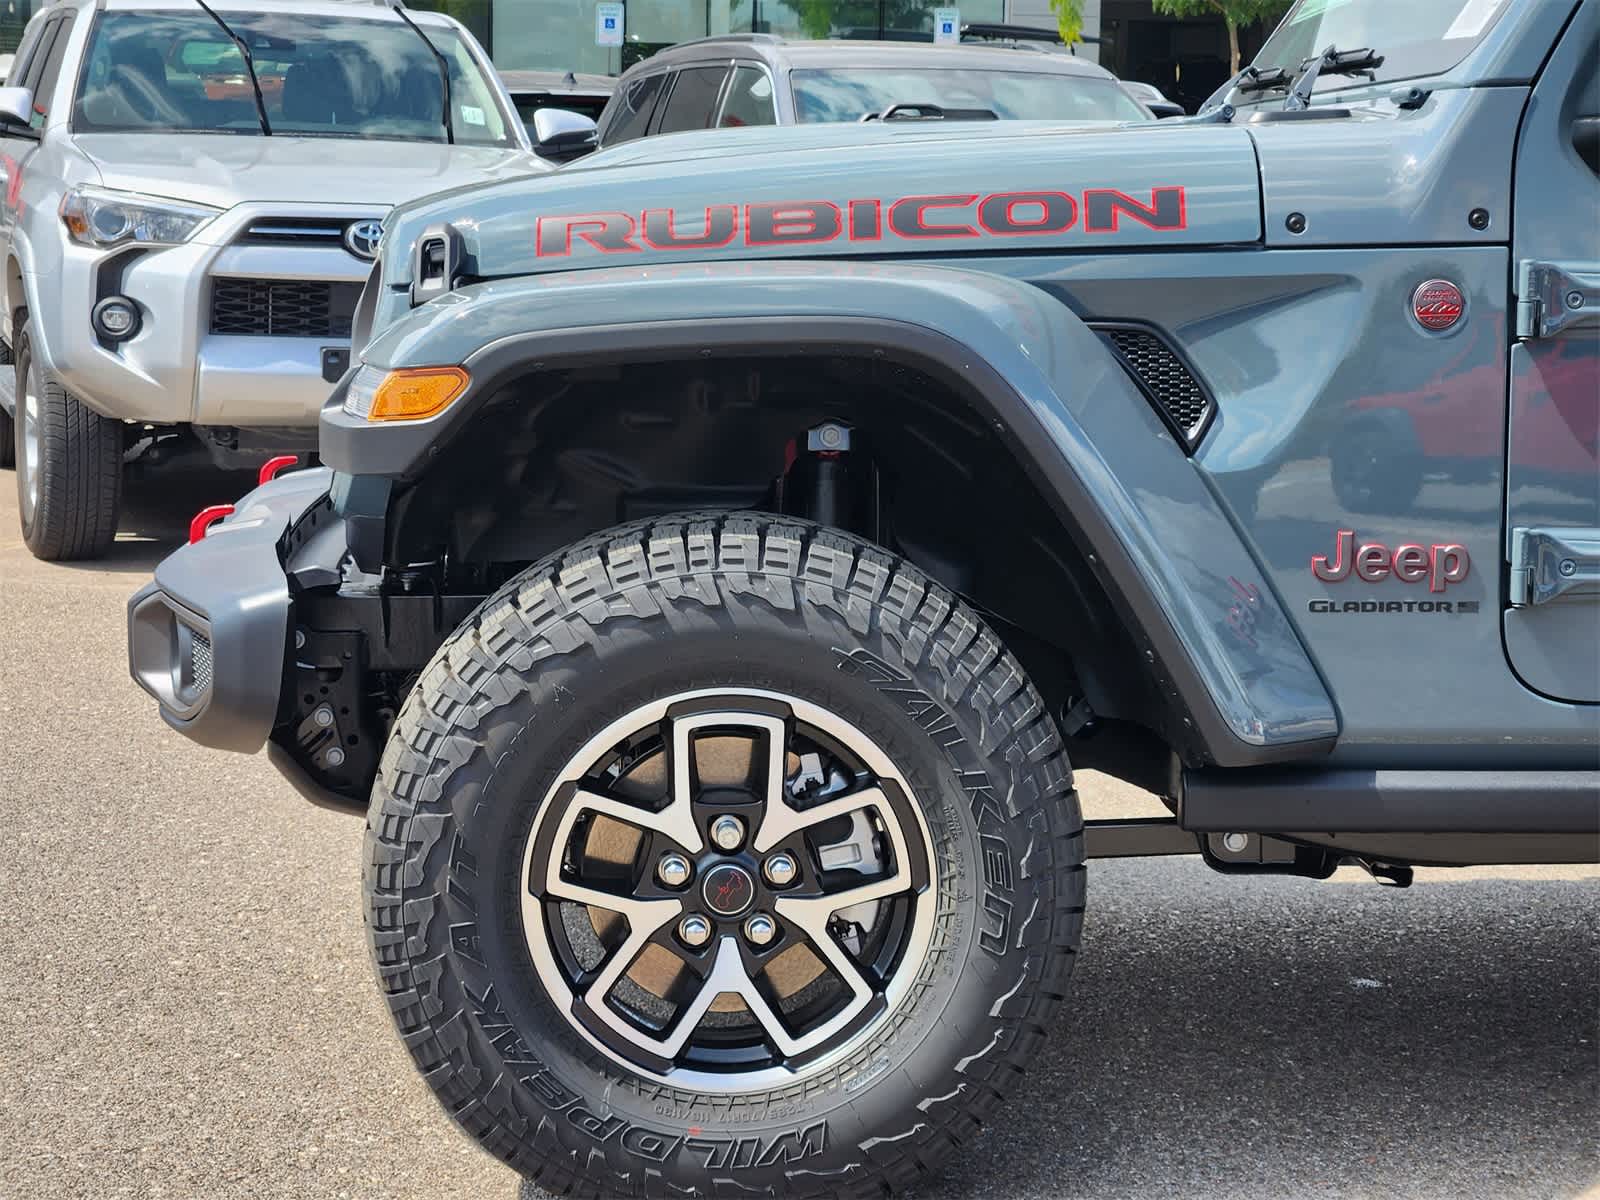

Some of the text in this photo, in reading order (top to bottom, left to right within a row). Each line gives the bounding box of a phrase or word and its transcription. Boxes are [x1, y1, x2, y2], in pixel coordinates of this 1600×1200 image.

[535, 185, 1186, 257] RUBICON
[1311, 529, 1471, 592] Jeep
[1308, 600, 1453, 614] GLADIATOR
[461, 980, 827, 1169] WILDPEAK
